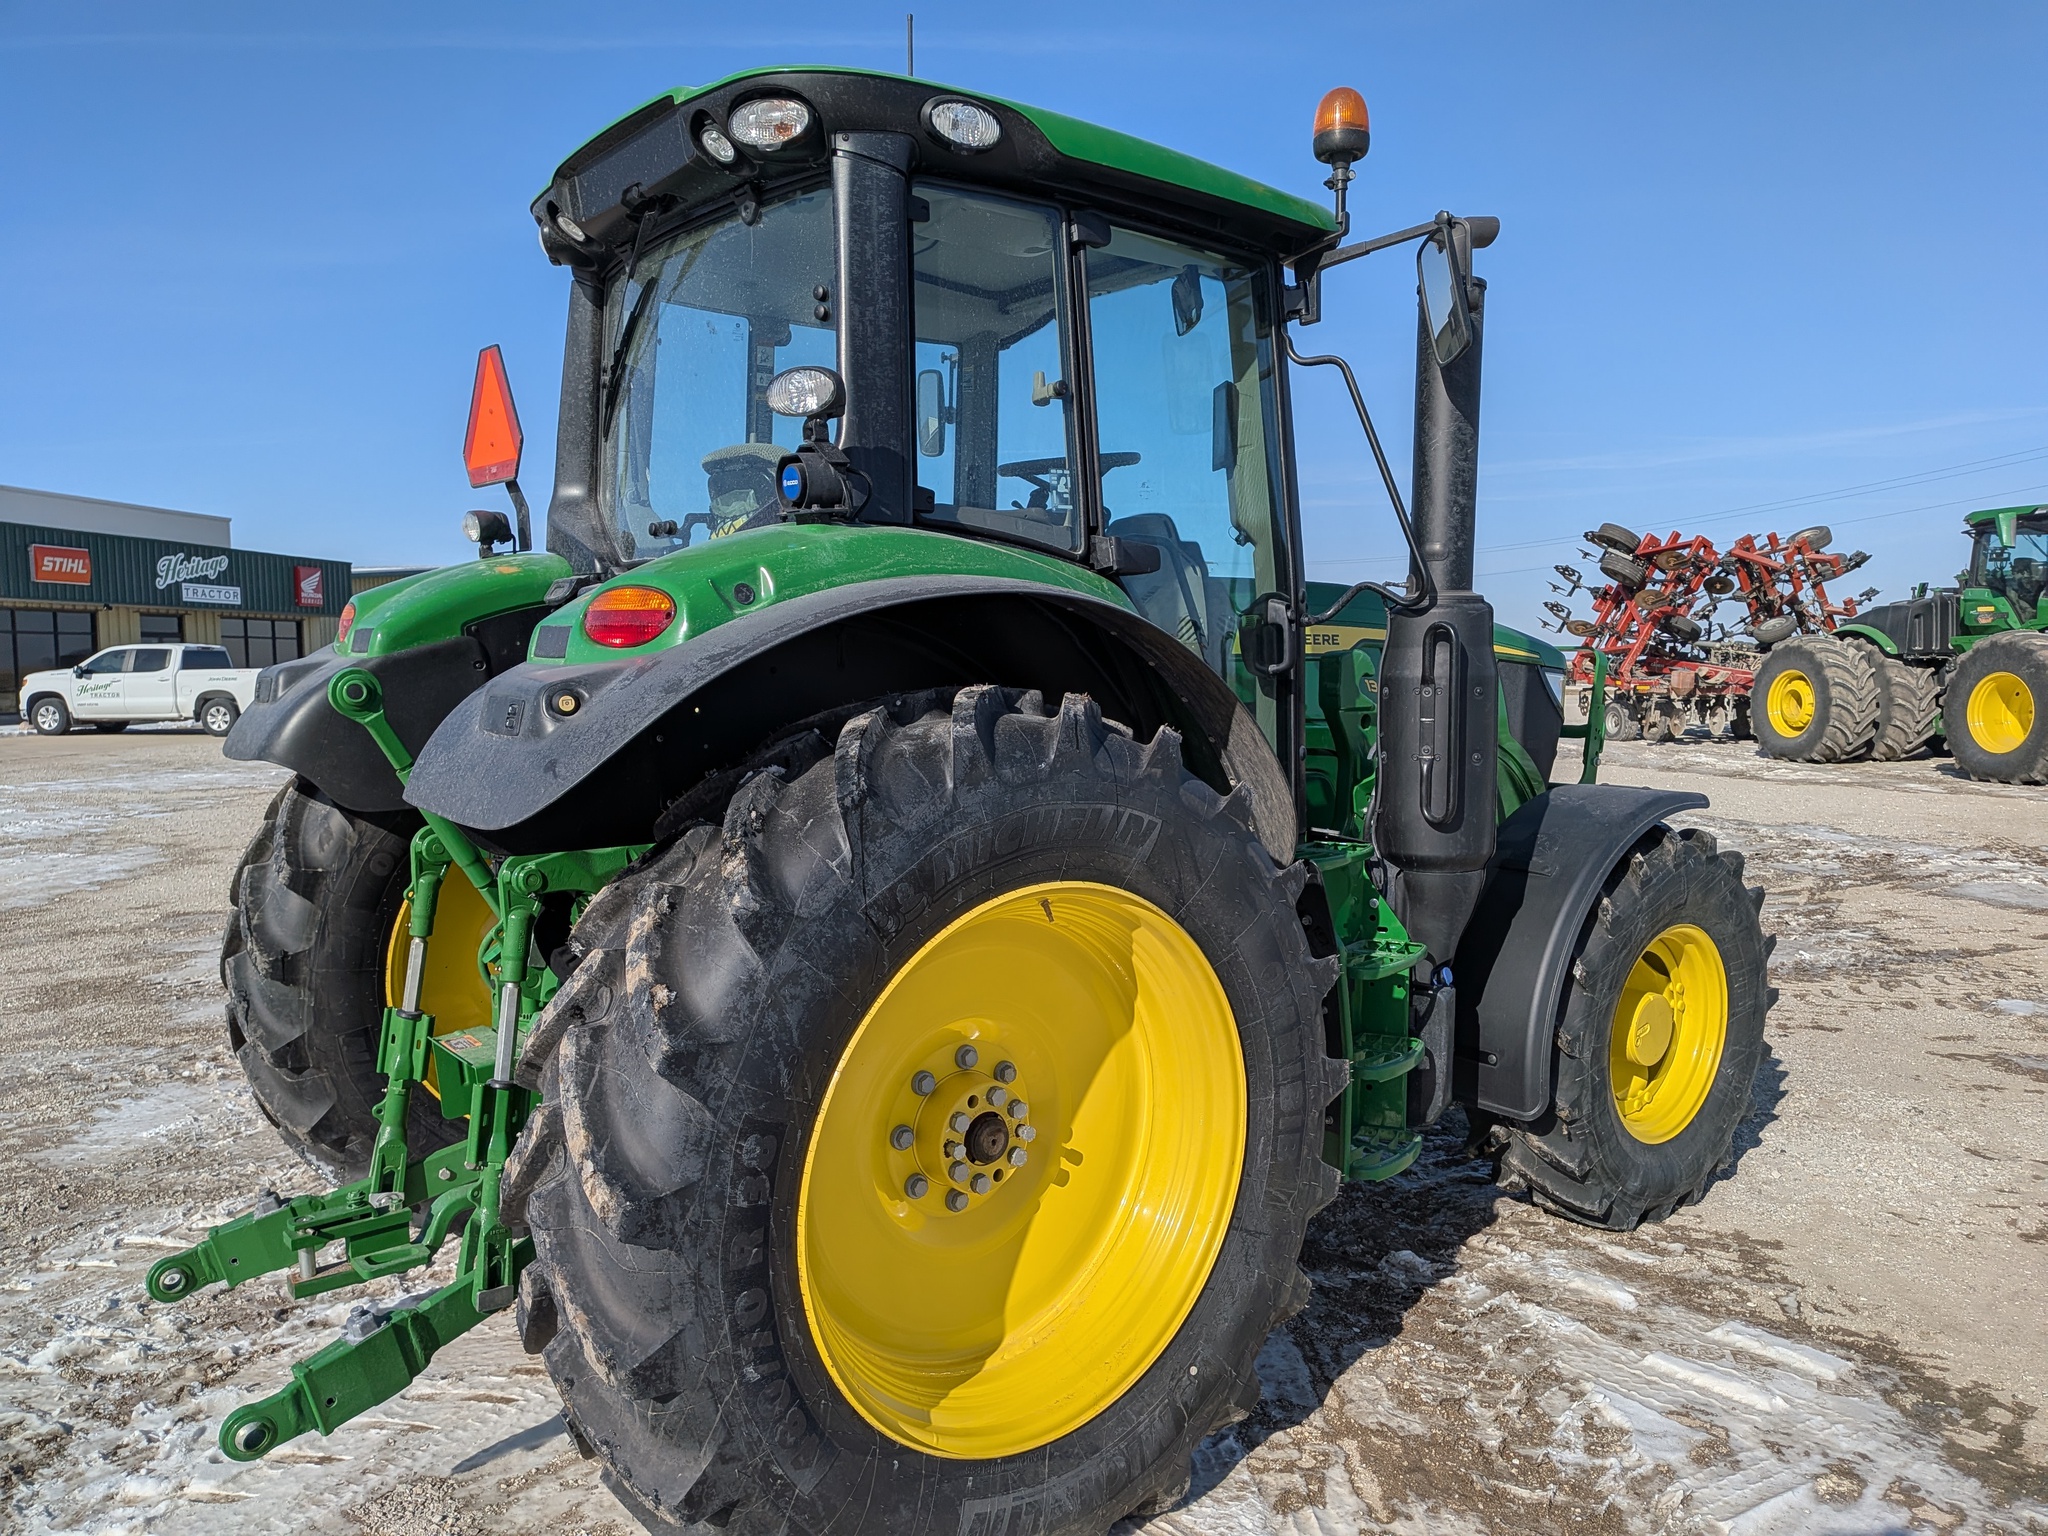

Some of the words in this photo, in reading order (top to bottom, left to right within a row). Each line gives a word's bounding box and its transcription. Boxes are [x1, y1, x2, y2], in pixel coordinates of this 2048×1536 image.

[41, 556, 88, 574] STIHL
[156, 553, 228, 589] Heritage
[184, 588, 239, 600] TRACTOR
[1305, 633, 1339, 646] EERE
[76, 682, 113, 697] Heritage
